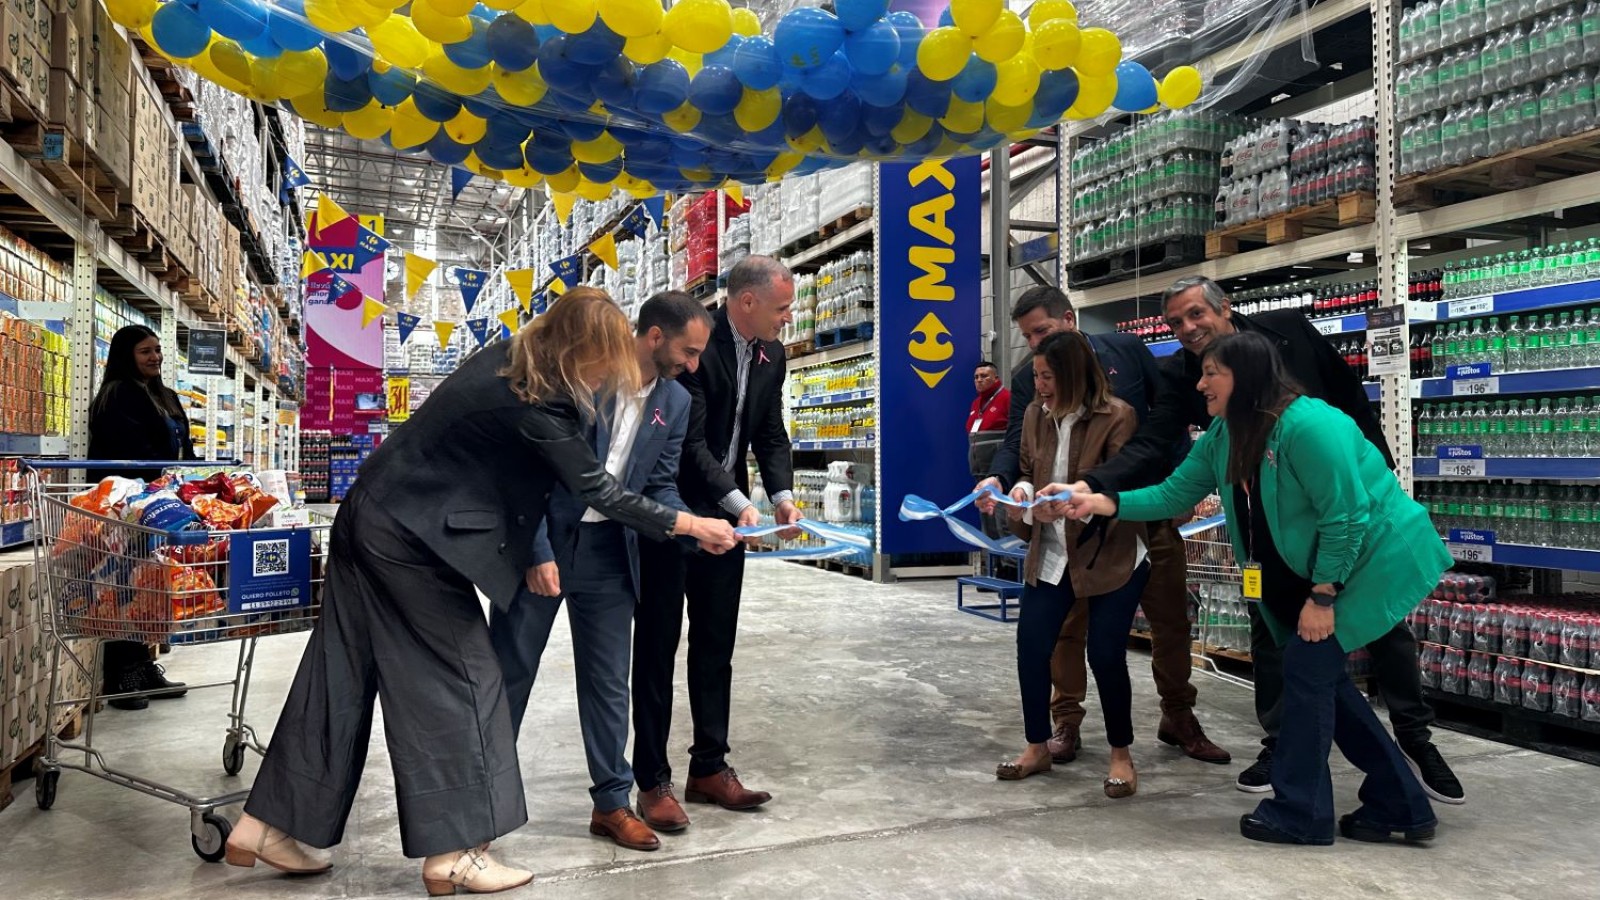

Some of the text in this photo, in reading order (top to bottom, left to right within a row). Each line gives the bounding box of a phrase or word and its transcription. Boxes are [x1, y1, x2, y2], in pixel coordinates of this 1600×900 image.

[561, 267, 575, 277] MAXI
[241, 590, 291, 600] QUIERO FOLLETO
